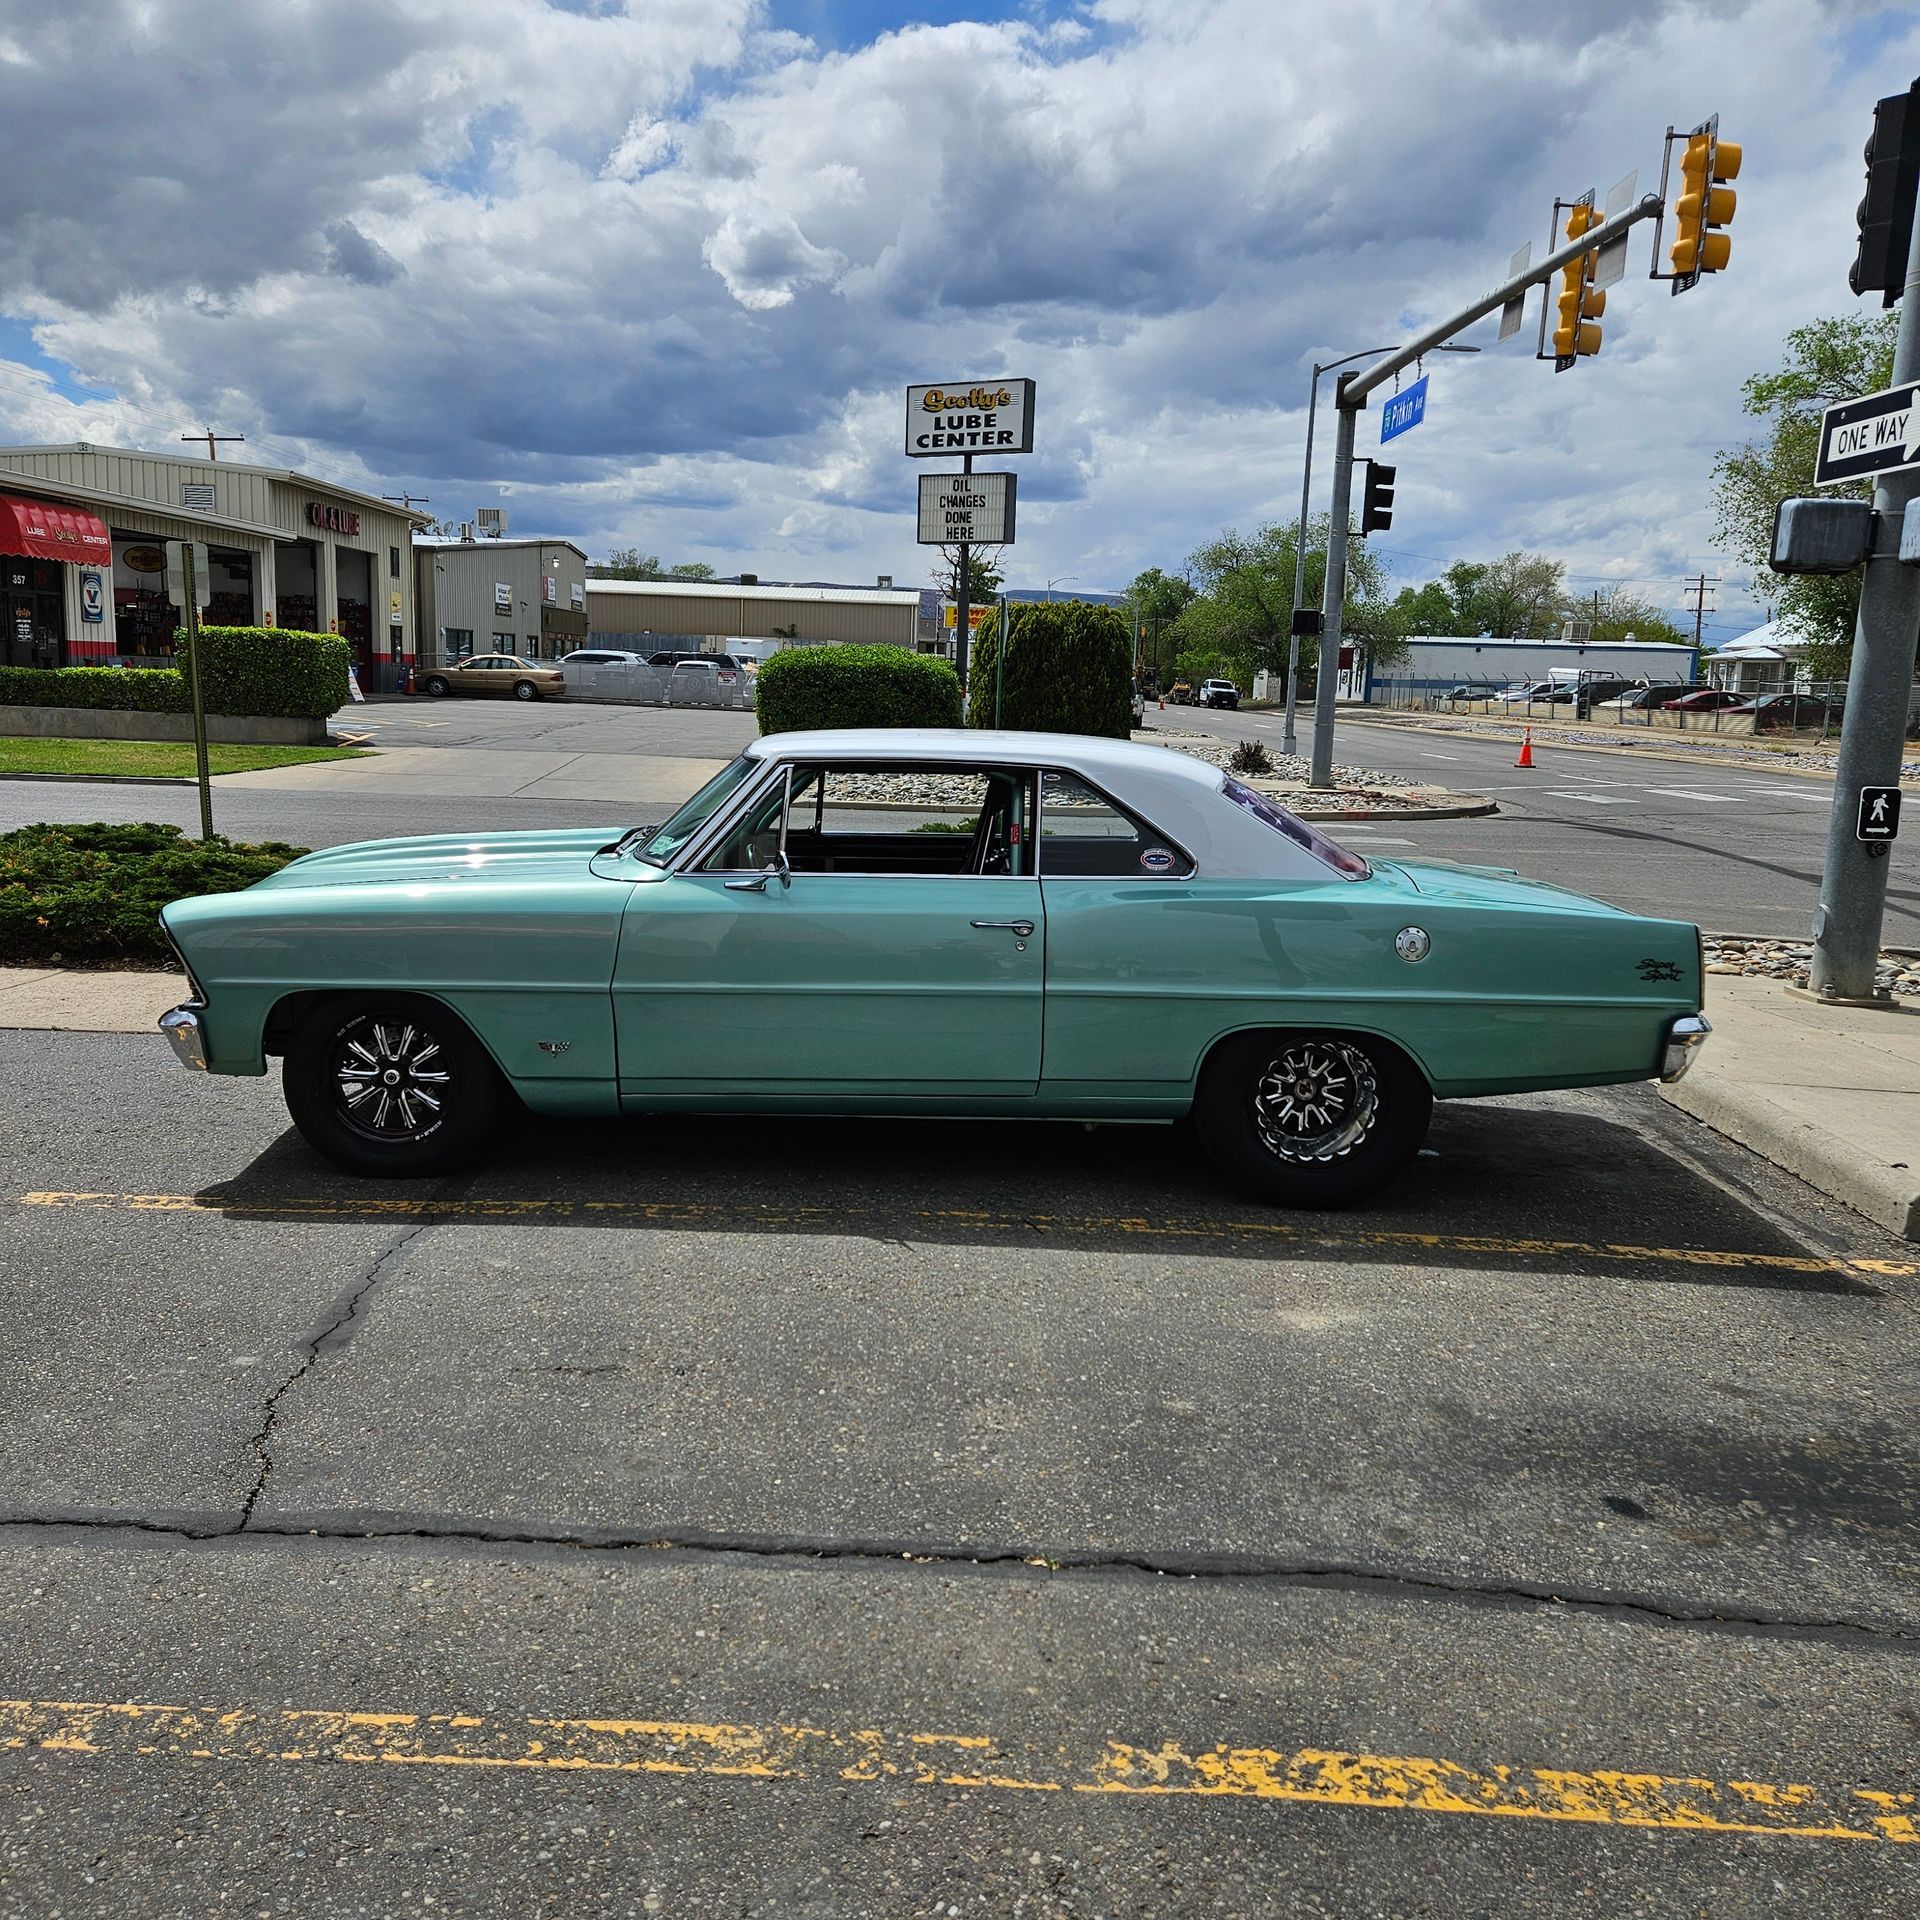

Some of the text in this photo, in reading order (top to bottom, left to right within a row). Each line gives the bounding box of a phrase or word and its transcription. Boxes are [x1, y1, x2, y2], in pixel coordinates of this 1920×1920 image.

[922, 387, 1011, 413] Scotty's
[1390, 396, 1413, 430] Pitkin
[934, 413, 997, 431] LUBE
[916, 430, 1014, 449] CENTER
[1838, 413, 1910, 455] ONE WAY
[952, 479, 971, 493] OIL
[939, 494, 986, 509] CHANGES
[945, 510, 973, 524] DONE
[26, 526, 46, 537] LUBE
[82, 535, 108, 545] CENTER
[946, 526, 974, 540] HERE
[12, 574, 26, 585] 357
[1635, 958, 1686, 973] Super
[1640, 969, 1682, 984] Sport
